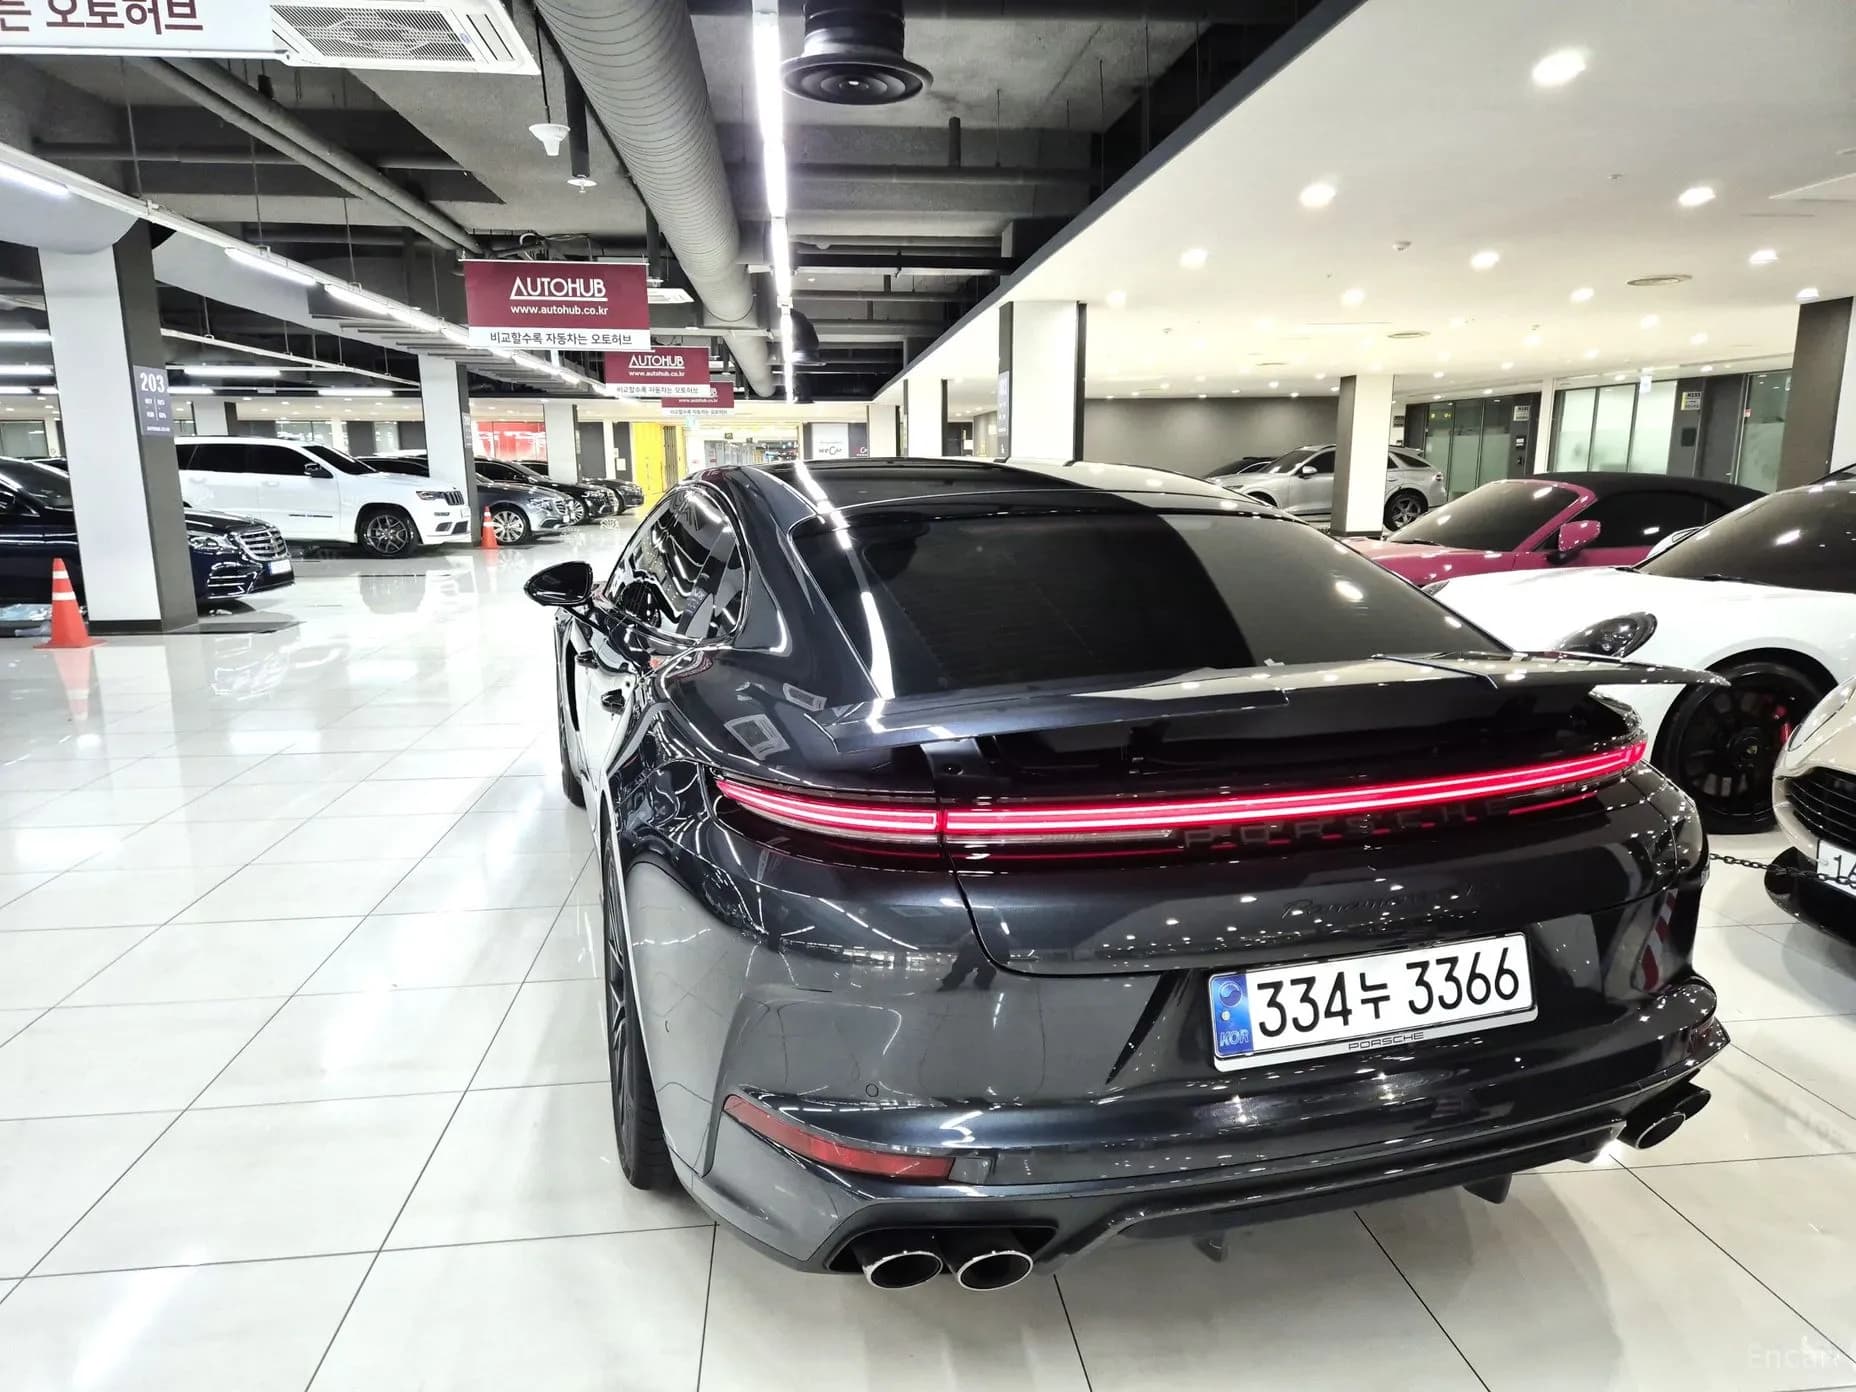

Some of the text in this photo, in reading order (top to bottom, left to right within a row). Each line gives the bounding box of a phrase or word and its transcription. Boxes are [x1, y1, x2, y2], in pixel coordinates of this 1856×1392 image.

[46, 0, 203, 35] 오토허브
[510, 276, 608, 301] AUTOHUB
[510, 305, 608, 315] www.autohub.co.kr
[490, 332, 632, 346] 비교할수록 자동차는 오토허브
[628, 354, 685, 369] AUTOHUB
[140, 372, 165, 393] 203
[1256, 947, 1520, 1038] 334누 3366
[1219, 1028, 1249, 1047] KOR
[1348, 1031, 1425, 1051] PORSCHE
